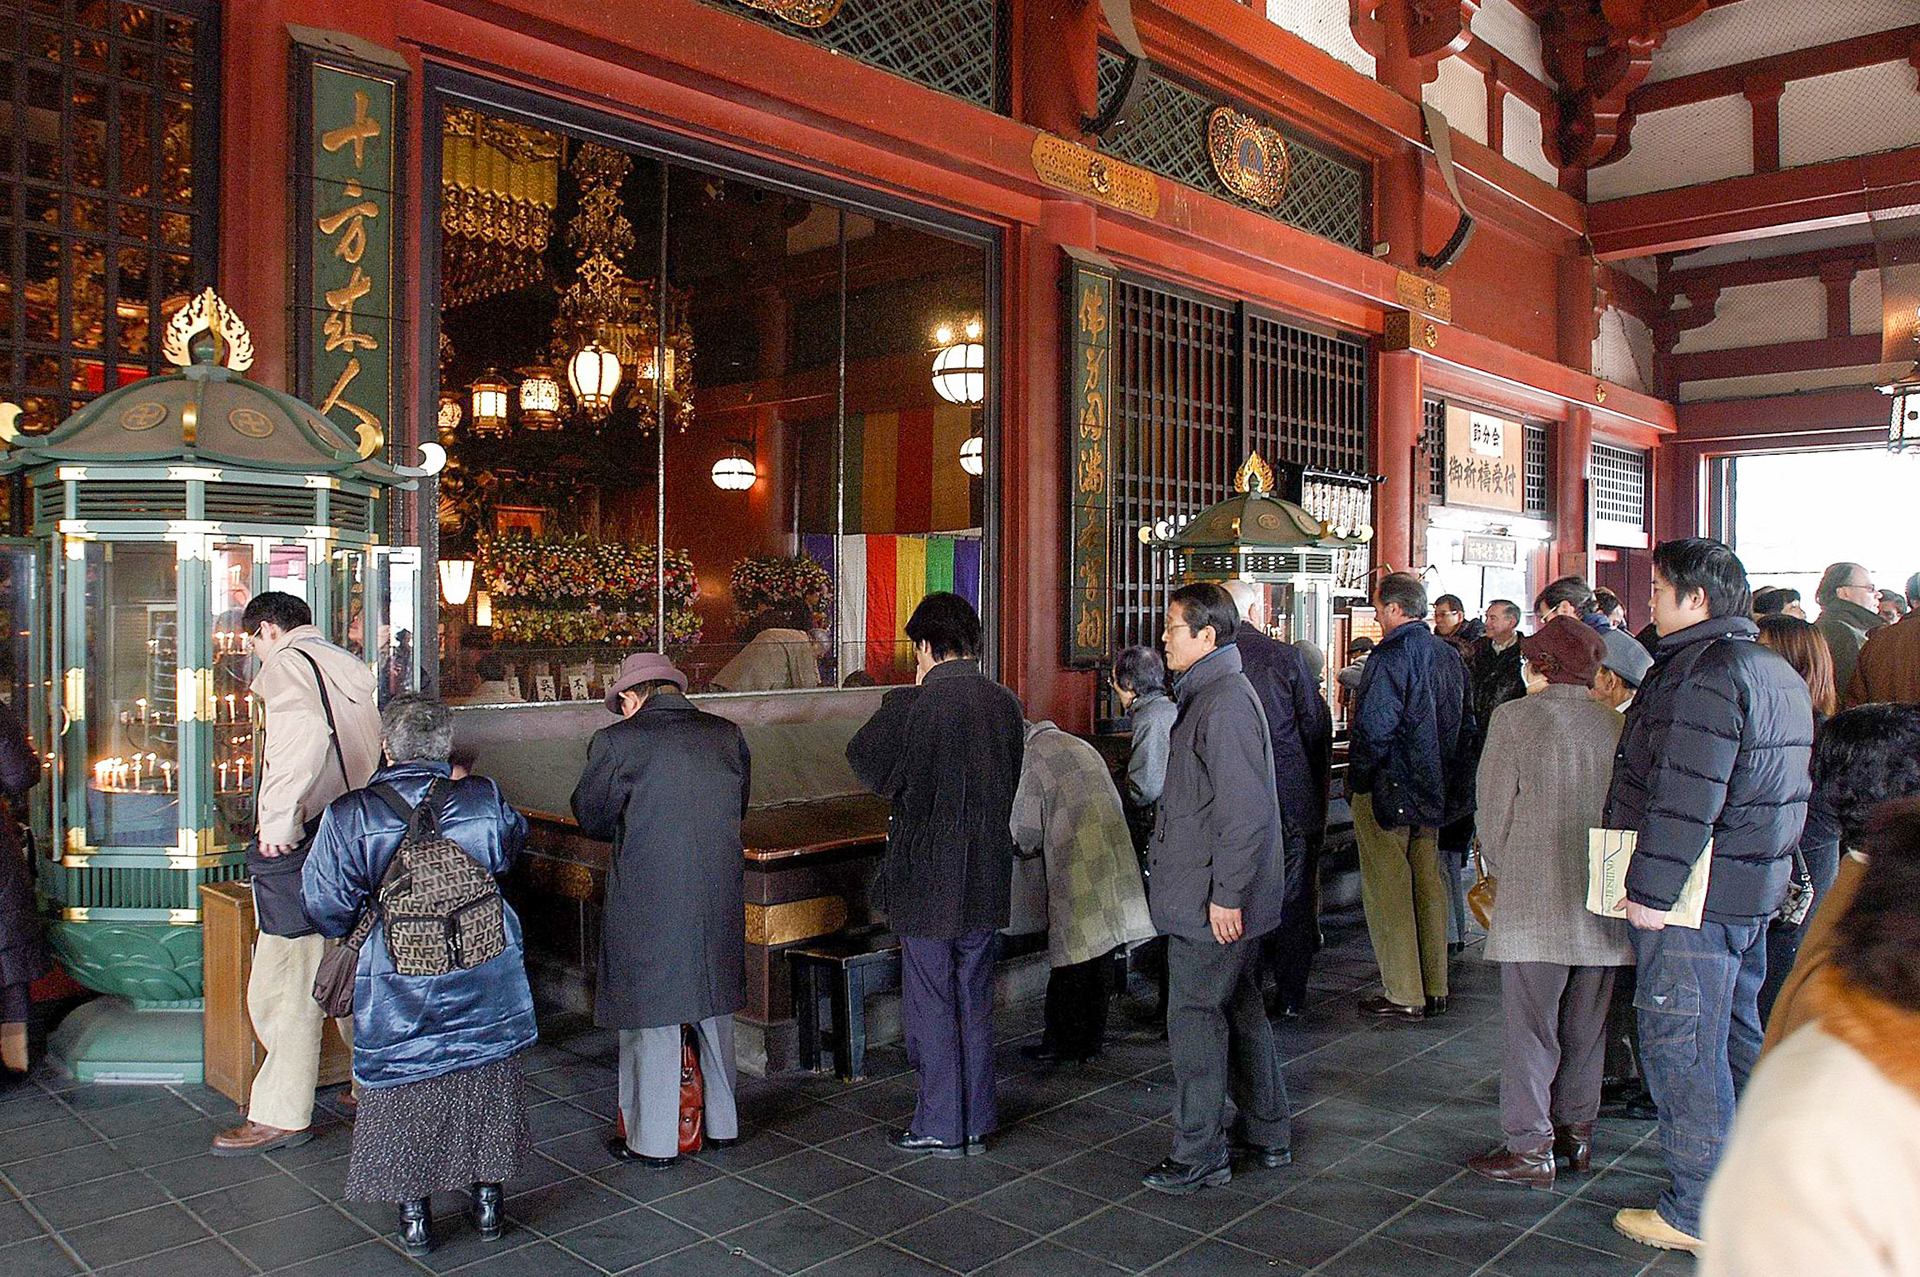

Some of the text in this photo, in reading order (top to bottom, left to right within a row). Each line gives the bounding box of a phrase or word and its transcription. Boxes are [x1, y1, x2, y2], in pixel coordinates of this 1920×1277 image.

[1474, 421, 1500, 447] 節分会
[1606, 860, 1616, 898] HOSHINO
